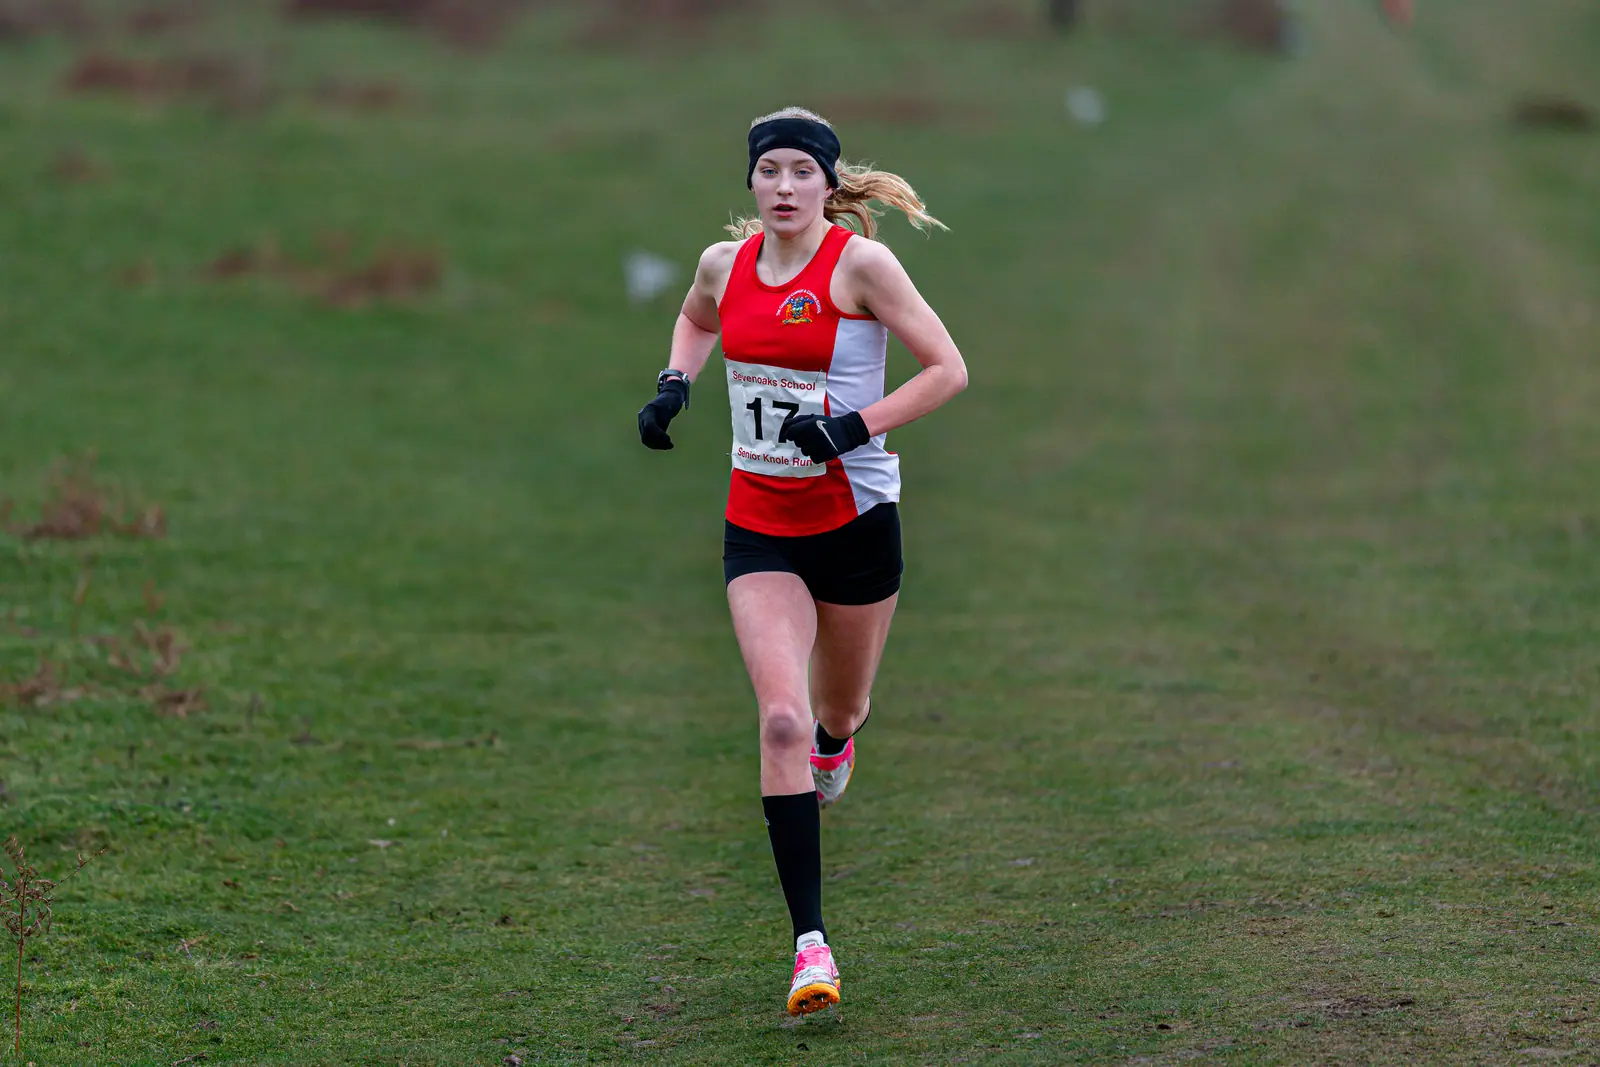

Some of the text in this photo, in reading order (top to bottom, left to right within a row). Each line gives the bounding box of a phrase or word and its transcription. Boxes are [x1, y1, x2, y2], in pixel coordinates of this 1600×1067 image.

[732, 370, 816, 391] Sevenoaks School
[746, 397, 800, 443] 17
[737, 447, 813, 467] Senior Knole Run
